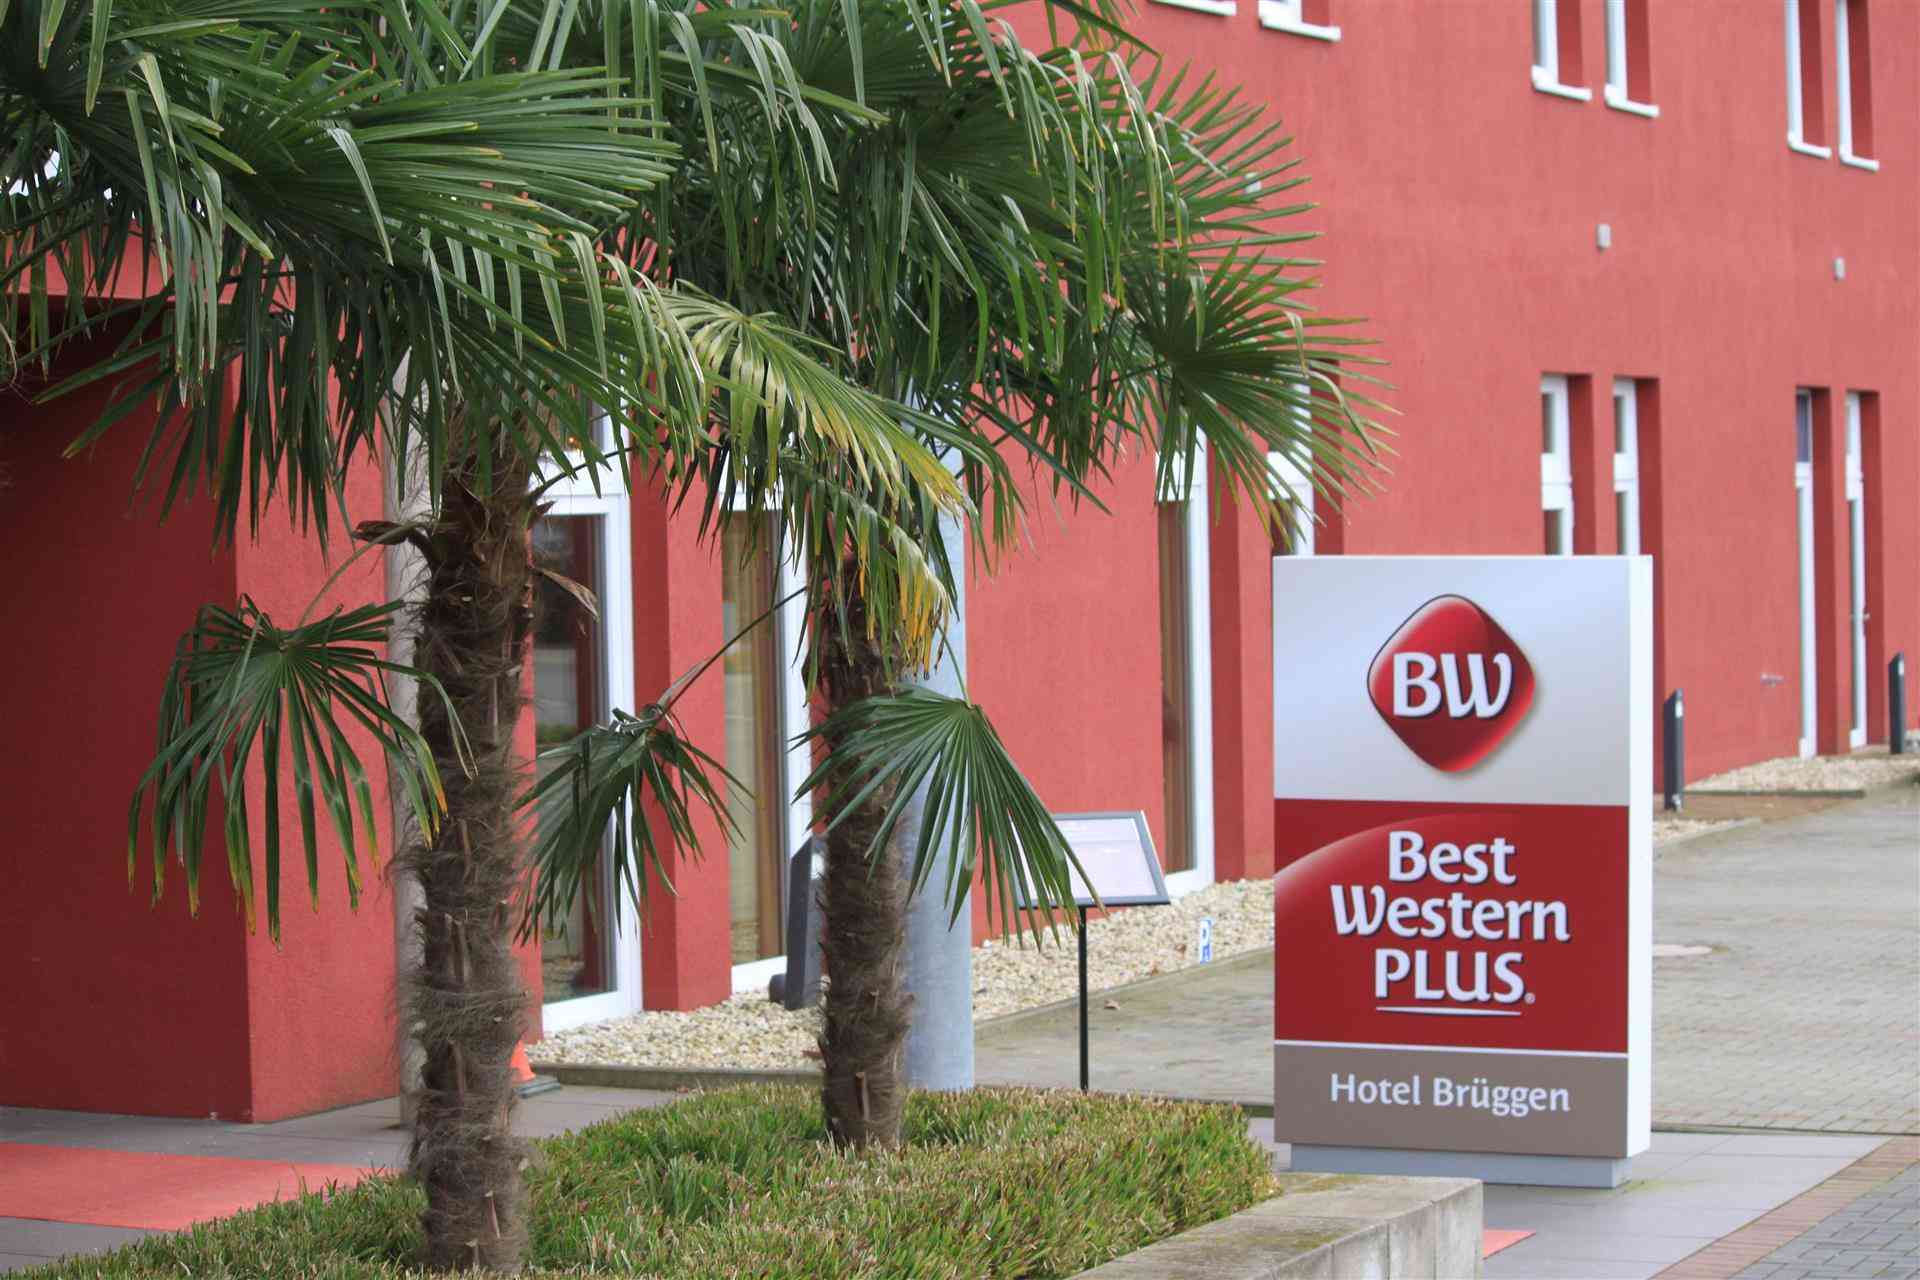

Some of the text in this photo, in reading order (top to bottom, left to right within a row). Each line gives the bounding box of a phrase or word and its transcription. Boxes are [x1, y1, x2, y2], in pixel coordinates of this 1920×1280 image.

[1392, 652, 1513, 719] BW
[1389, 831, 1516, 884] Best
[1331, 885, 1570, 941] Western
[1331, 1073, 1570, 1117] Hotel Brüggen
